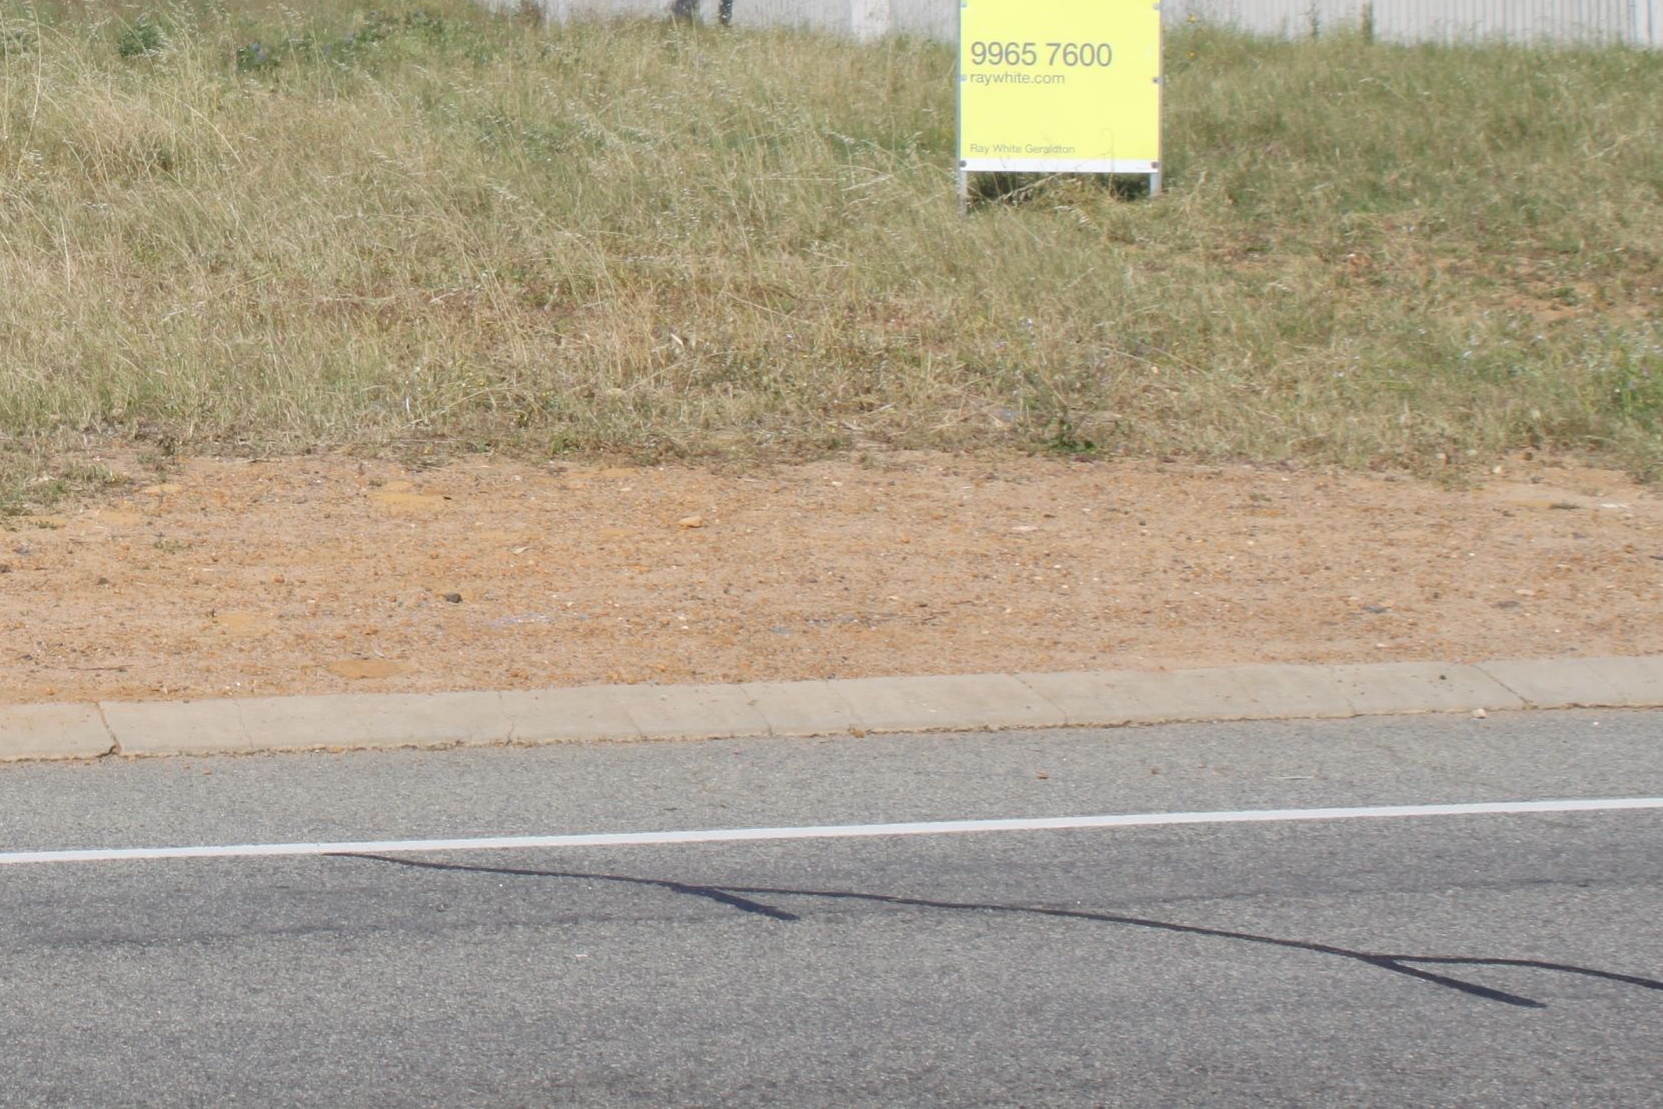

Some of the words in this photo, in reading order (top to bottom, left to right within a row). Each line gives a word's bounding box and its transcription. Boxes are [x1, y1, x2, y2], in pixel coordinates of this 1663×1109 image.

[971, 41, 1037, 66] 9965
[1046, 42, 1113, 67] 7600
[970, 71, 1065, 86] raywhite.com
[970, 144, 989, 155] Ray
[993, 144, 1022, 154] White
[1024, 144, 1075, 155] Geraldton
